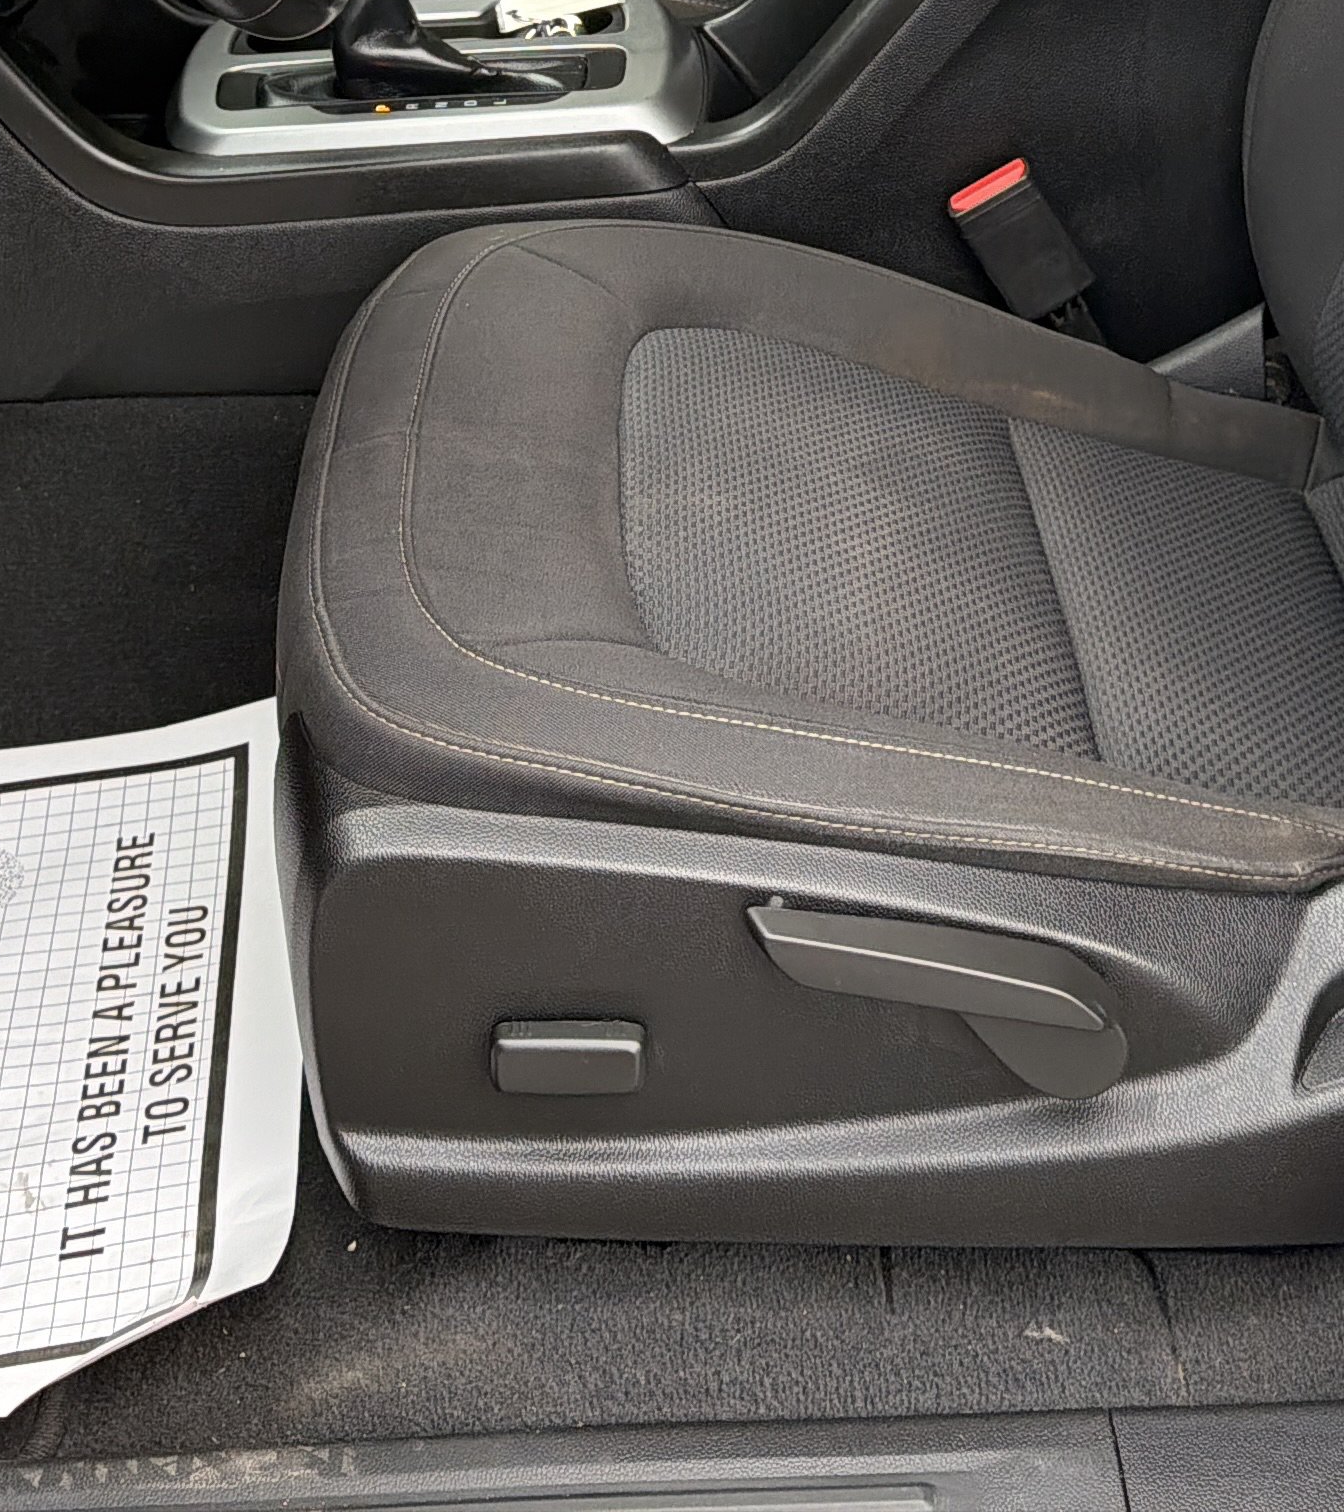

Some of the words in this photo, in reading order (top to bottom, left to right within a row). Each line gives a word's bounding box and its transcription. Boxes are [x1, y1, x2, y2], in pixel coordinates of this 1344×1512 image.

[96, 831, 156, 993] PLEASURE
[162, 904, 210, 973] YOU
[92, 999, 136, 1023] A
[148, 975, 201, 1085] SERVE
[77, 1032, 131, 1123] BEEN
[141, 1095, 191, 1146] TO
[65, 1130, 118, 1210] HAS
[58, 1226, 106, 1262] IT
